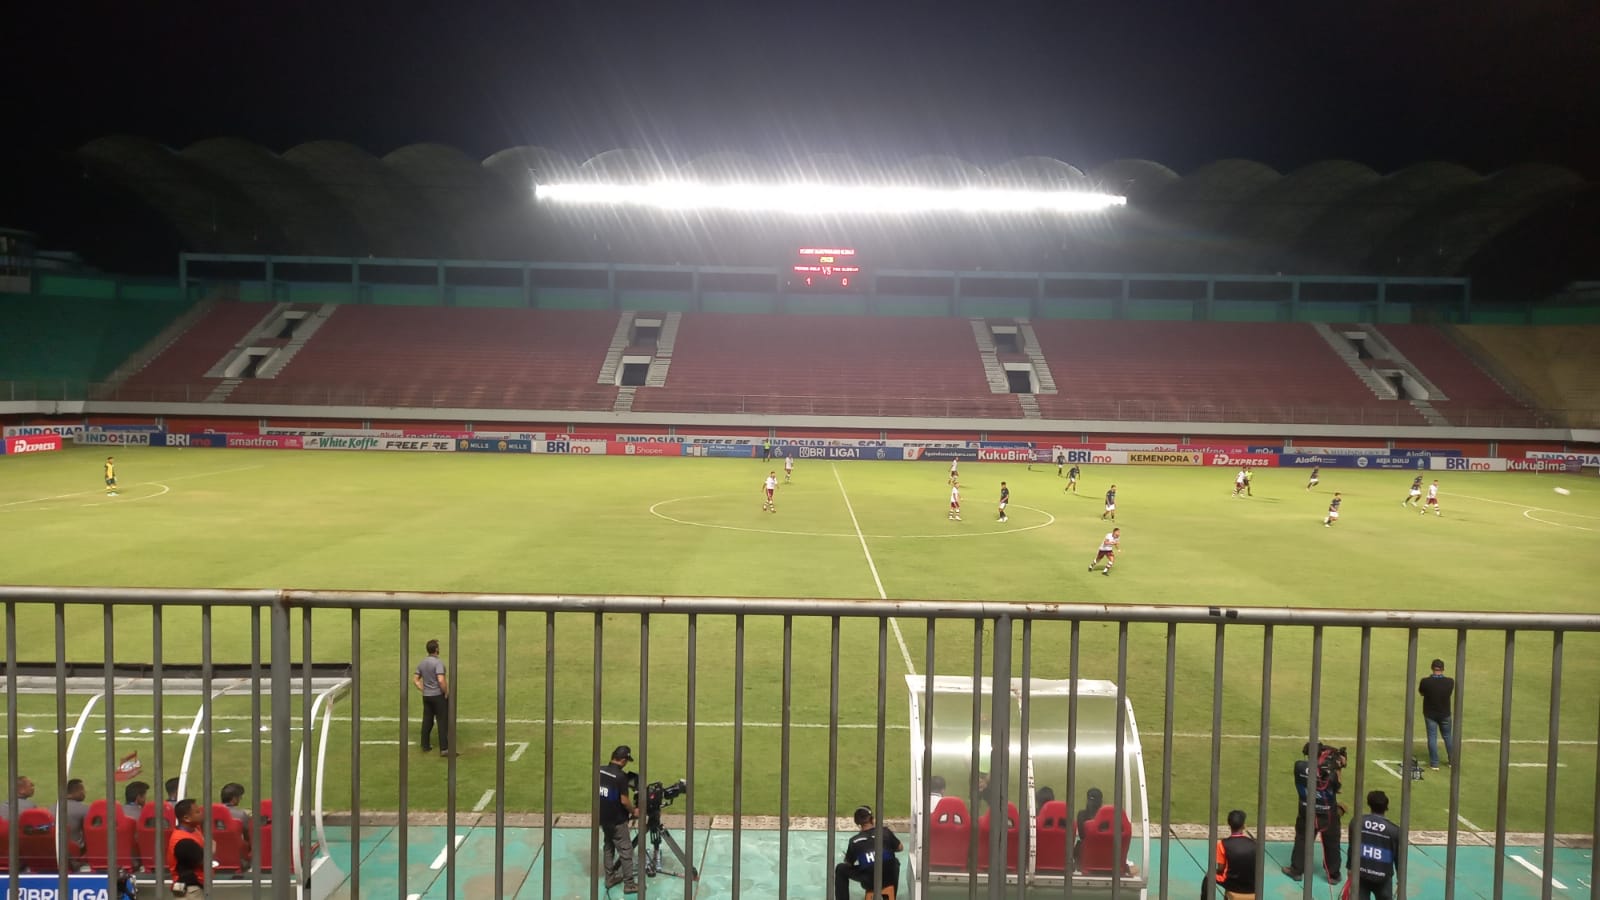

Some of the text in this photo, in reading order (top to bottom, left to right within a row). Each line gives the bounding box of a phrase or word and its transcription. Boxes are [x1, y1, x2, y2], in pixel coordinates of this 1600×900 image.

[86, 434, 148, 443] INDOSIAR
[229, 437, 279, 447] smartfren
[320, 437, 347, 448] White
[386, 441, 419, 449] FREE
[636, 446, 663, 454] Shopee
[809, 446, 826, 457] BRI
[1129, 454, 1190, 463] KEMENPORA
[1295, 455, 1322, 464] Aladin
[1506, 460, 1567, 471] KukuBima
[1364, 820, 1386, 832] 029
[1362, 845, 1382, 860] HB
